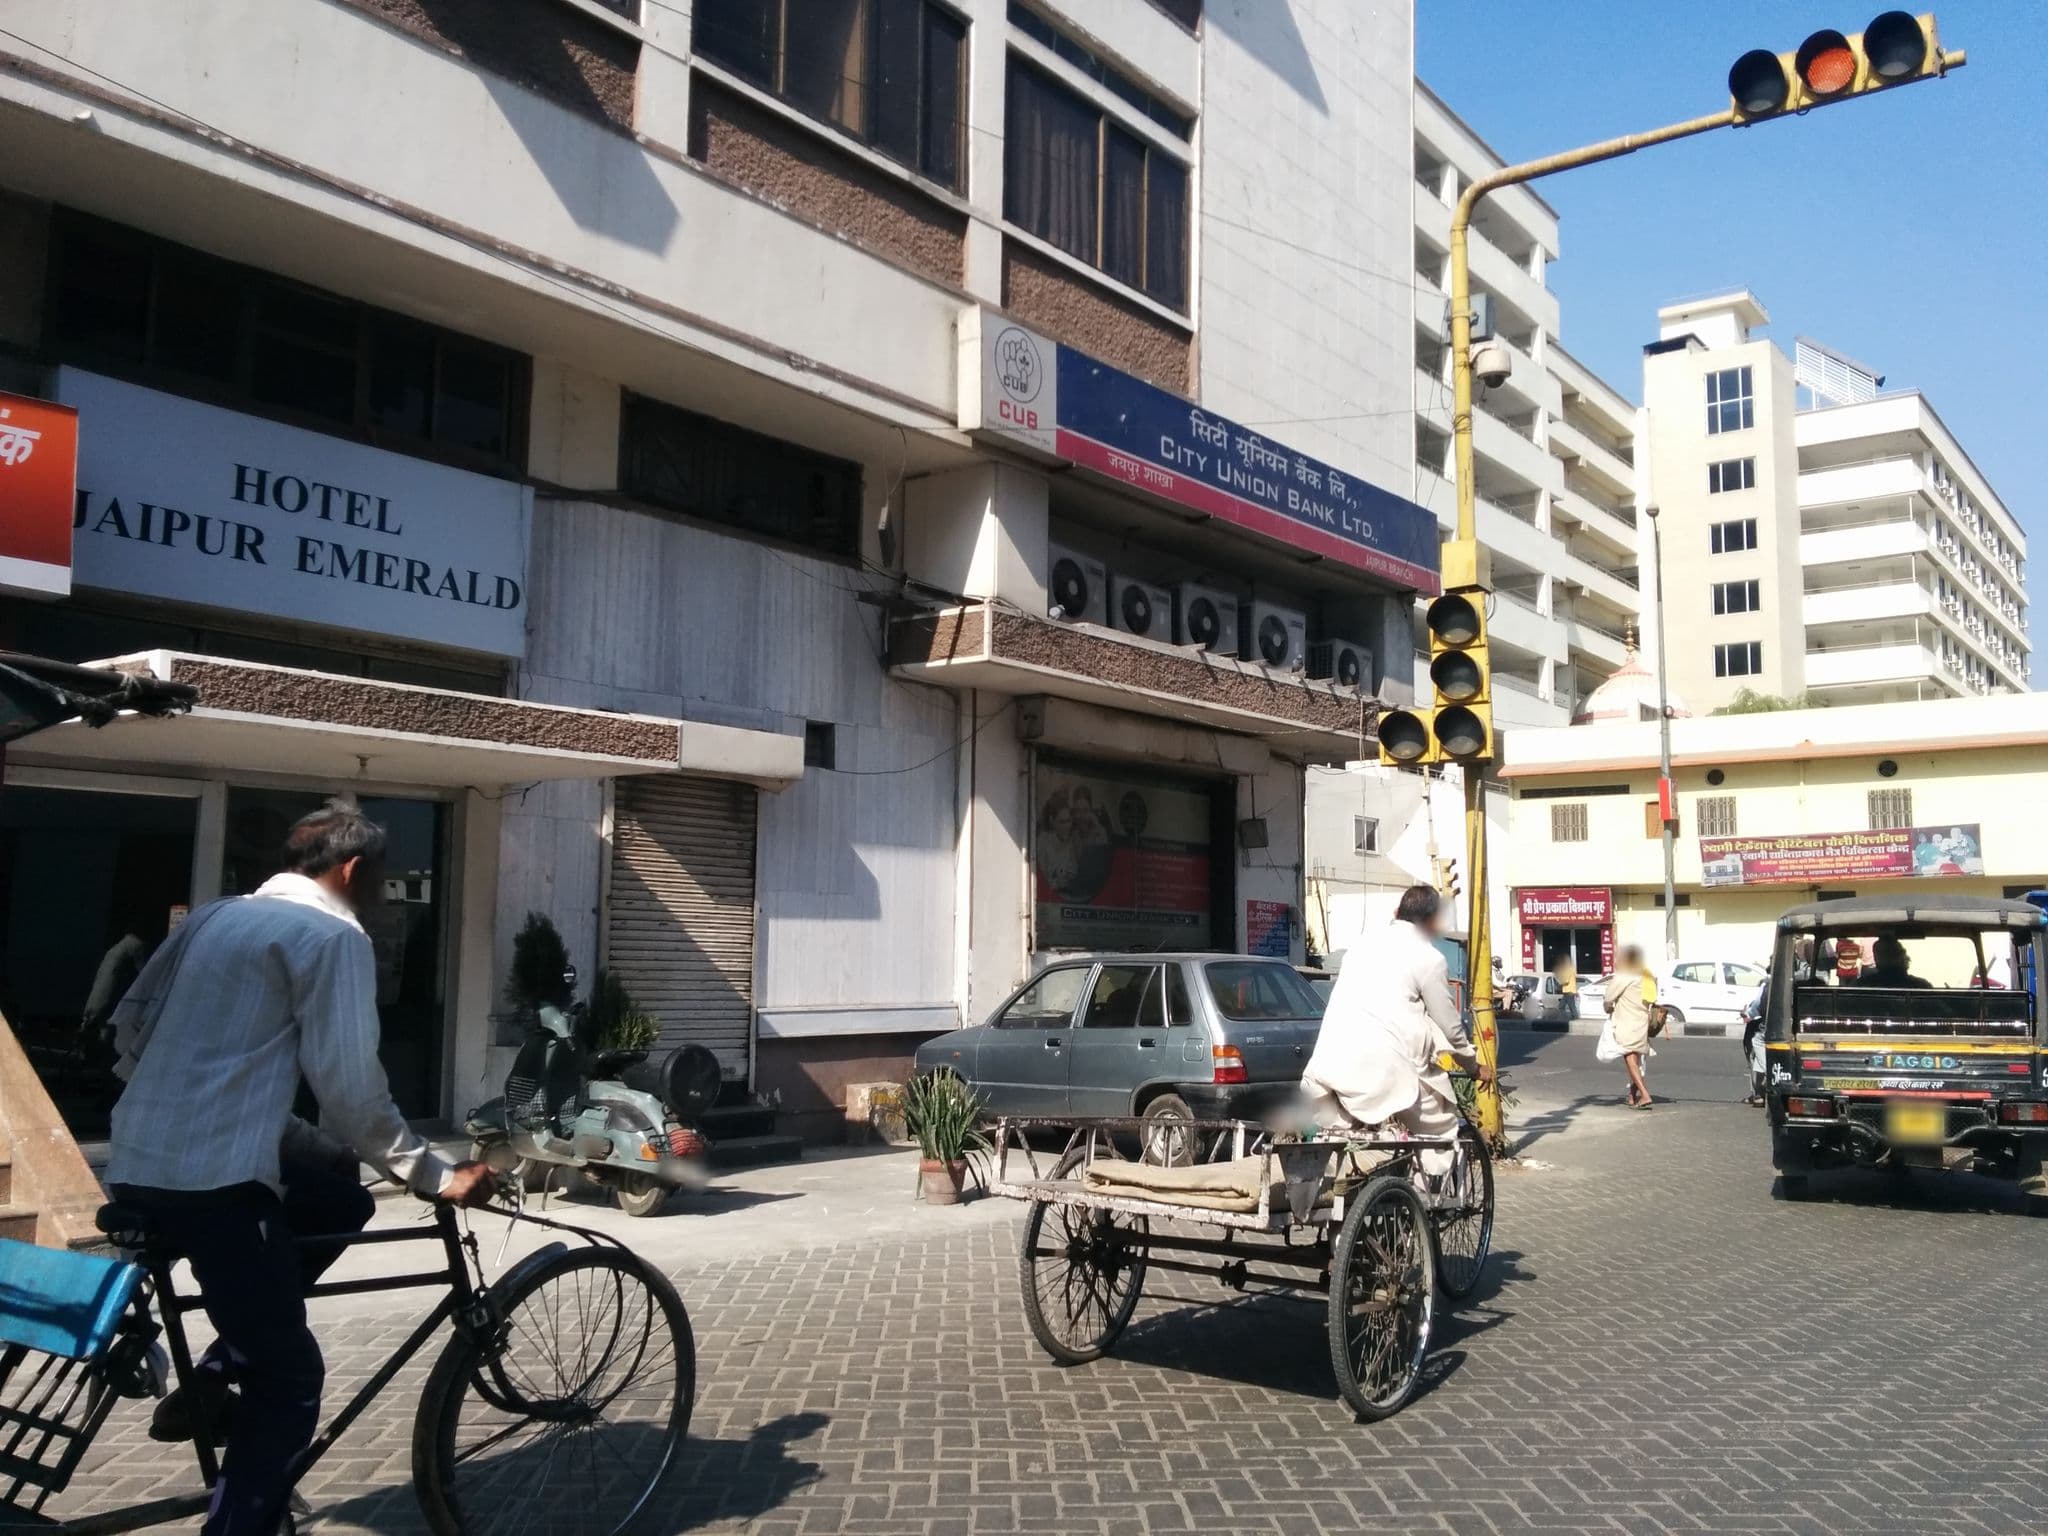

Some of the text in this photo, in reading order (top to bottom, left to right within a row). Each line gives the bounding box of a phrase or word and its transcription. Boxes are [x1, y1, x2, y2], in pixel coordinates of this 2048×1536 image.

[1003, 375, 1028, 394] CUB
[999, 400, 1038, 430] CUB
[1107, 451, 1174, 492] जयपुर शाखा
[1189, 408, 1229, 452] सिटी
[1236, 434, 1288, 477] यूनियन
[1295, 452, 1322, 489] बैंक
[230, 463, 402, 536] HOTEL
[1160, 436, 1209, 473] CITY
[1217, 459, 1279, 503] UNION
[1287, 488, 1335, 526] BANK
[72, 489, 521, 610] JAIPUR EMERALD
[1871, 1054, 1958, 1069] PIAGGIO
